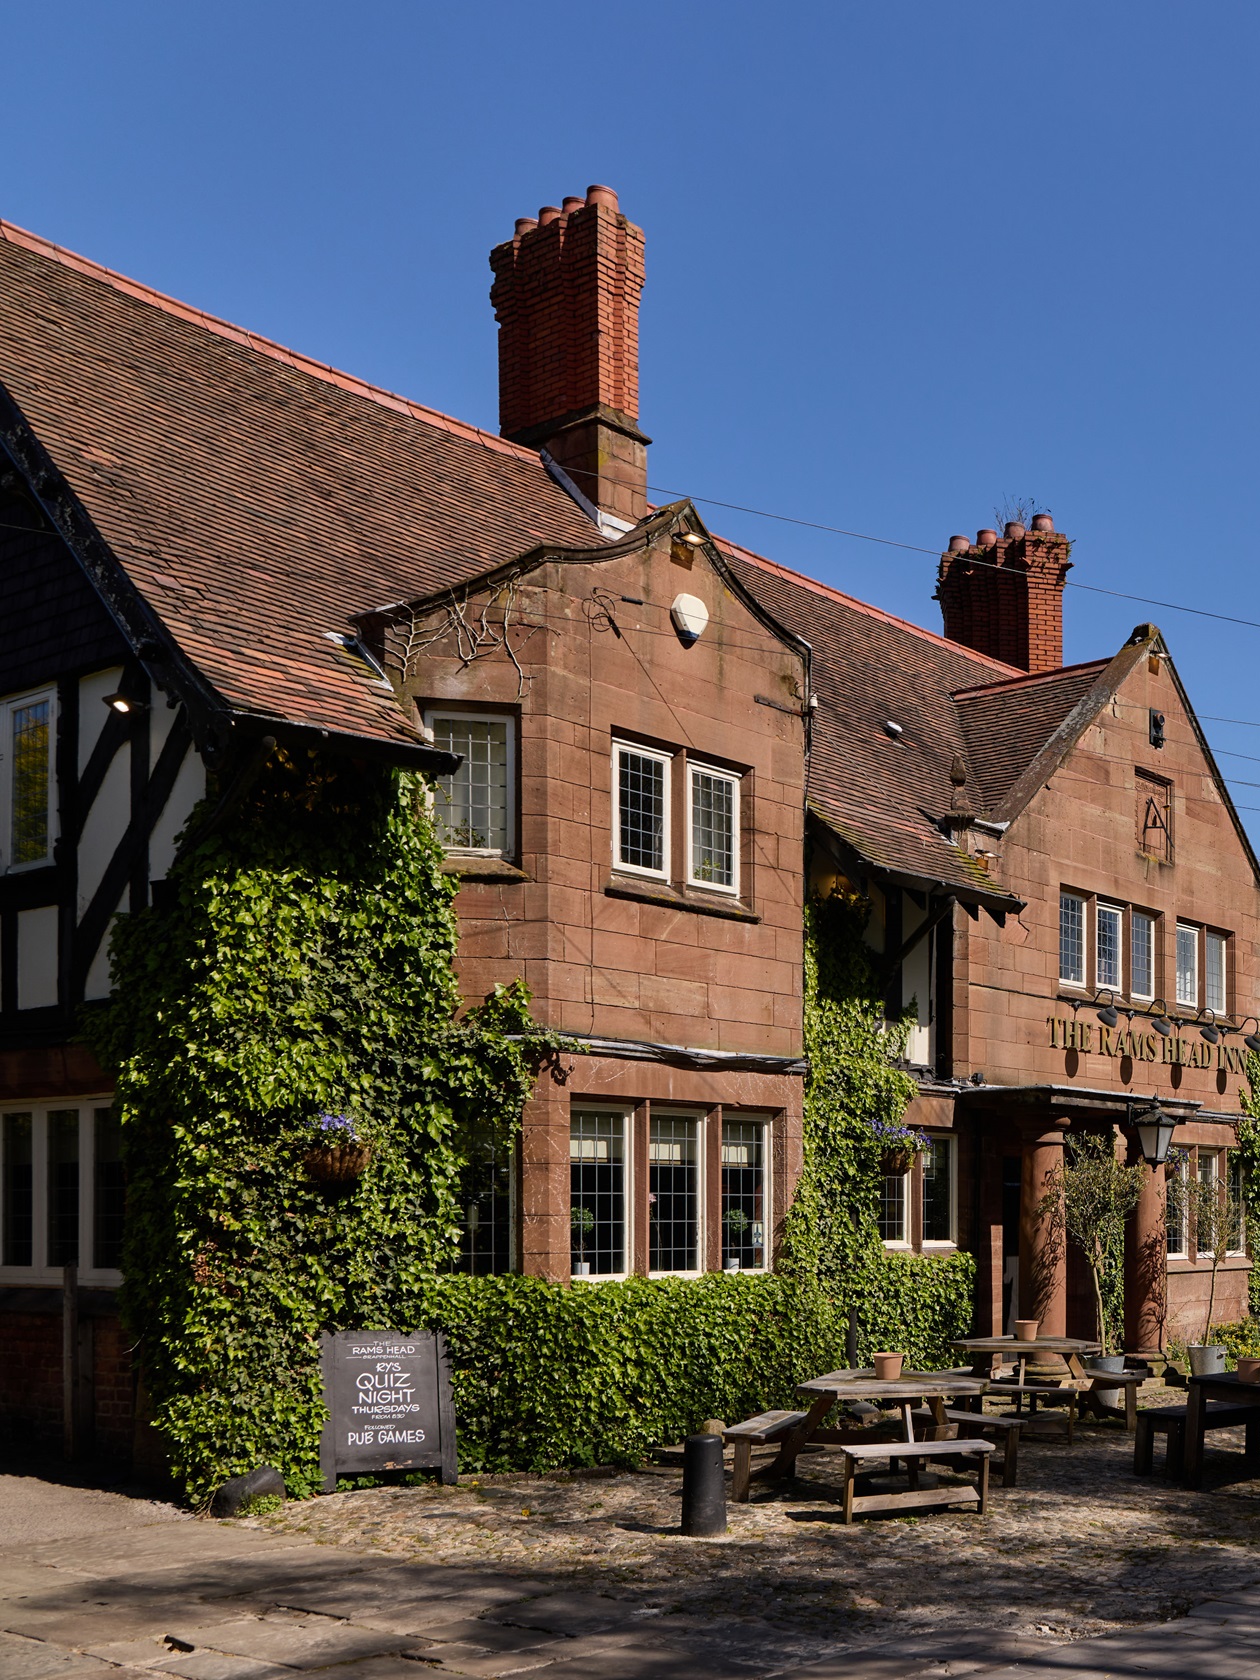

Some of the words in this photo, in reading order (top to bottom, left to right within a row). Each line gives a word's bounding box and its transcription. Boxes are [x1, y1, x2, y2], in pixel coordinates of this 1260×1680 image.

[1048, 1016, 1093, 1052] THE
[1098, 1025, 1158, 1062] RAMS
[1161, 1036, 1213, 1068] HEAD
[1217, 1044, 1247, 1074] INN
[353, 1346, 383, 1354] RAMS
[356, 1373, 411, 1390] QUIZ
[359, 1388, 416, 1404] NIGHT
[352, 1404, 420, 1414] THURSDAYS
[348, 1431, 374, 1445] PUB
[378, 1430, 425, 1444] GAMES
